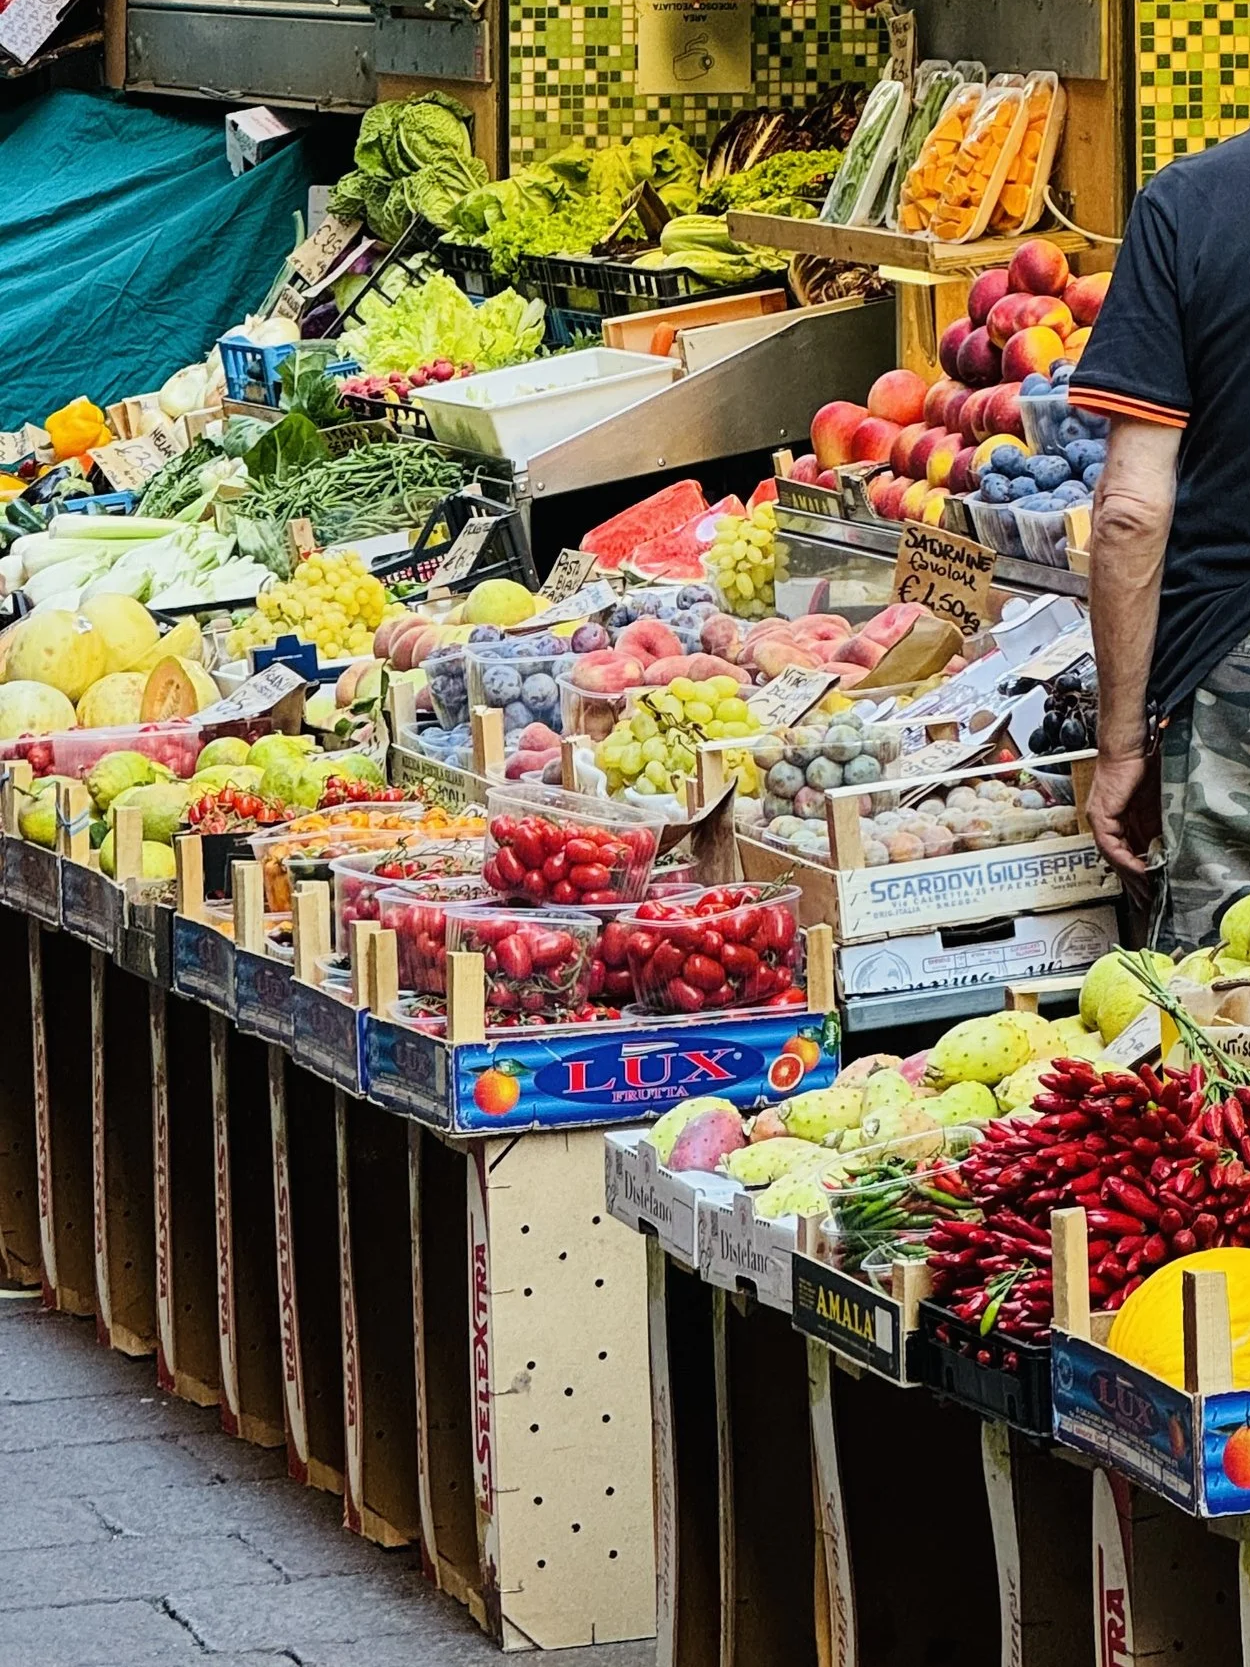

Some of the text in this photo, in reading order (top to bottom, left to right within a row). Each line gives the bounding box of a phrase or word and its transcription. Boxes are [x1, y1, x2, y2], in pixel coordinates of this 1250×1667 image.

[652, 2, 738, 11] VIDEOSOVEGLIATA
[683, 14, 707, 23] AREA
[905, 526, 997, 573] SATURNINE
[870, 846, 1097, 903] SCARDOVI GIUSEPPE
[999, 878, 1049, 893] FAENZA
[562, 1048, 737, 1094] LUX
[612, 1086, 689, 1103] FRUTTA
[624, 1170, 672, 1225] Distefano
[816, 1285, 876, 1343] AMALA
[463, 1242, 502, 1464] SELEXTRA
[1097, 1375, 1155, 1430] LUX
